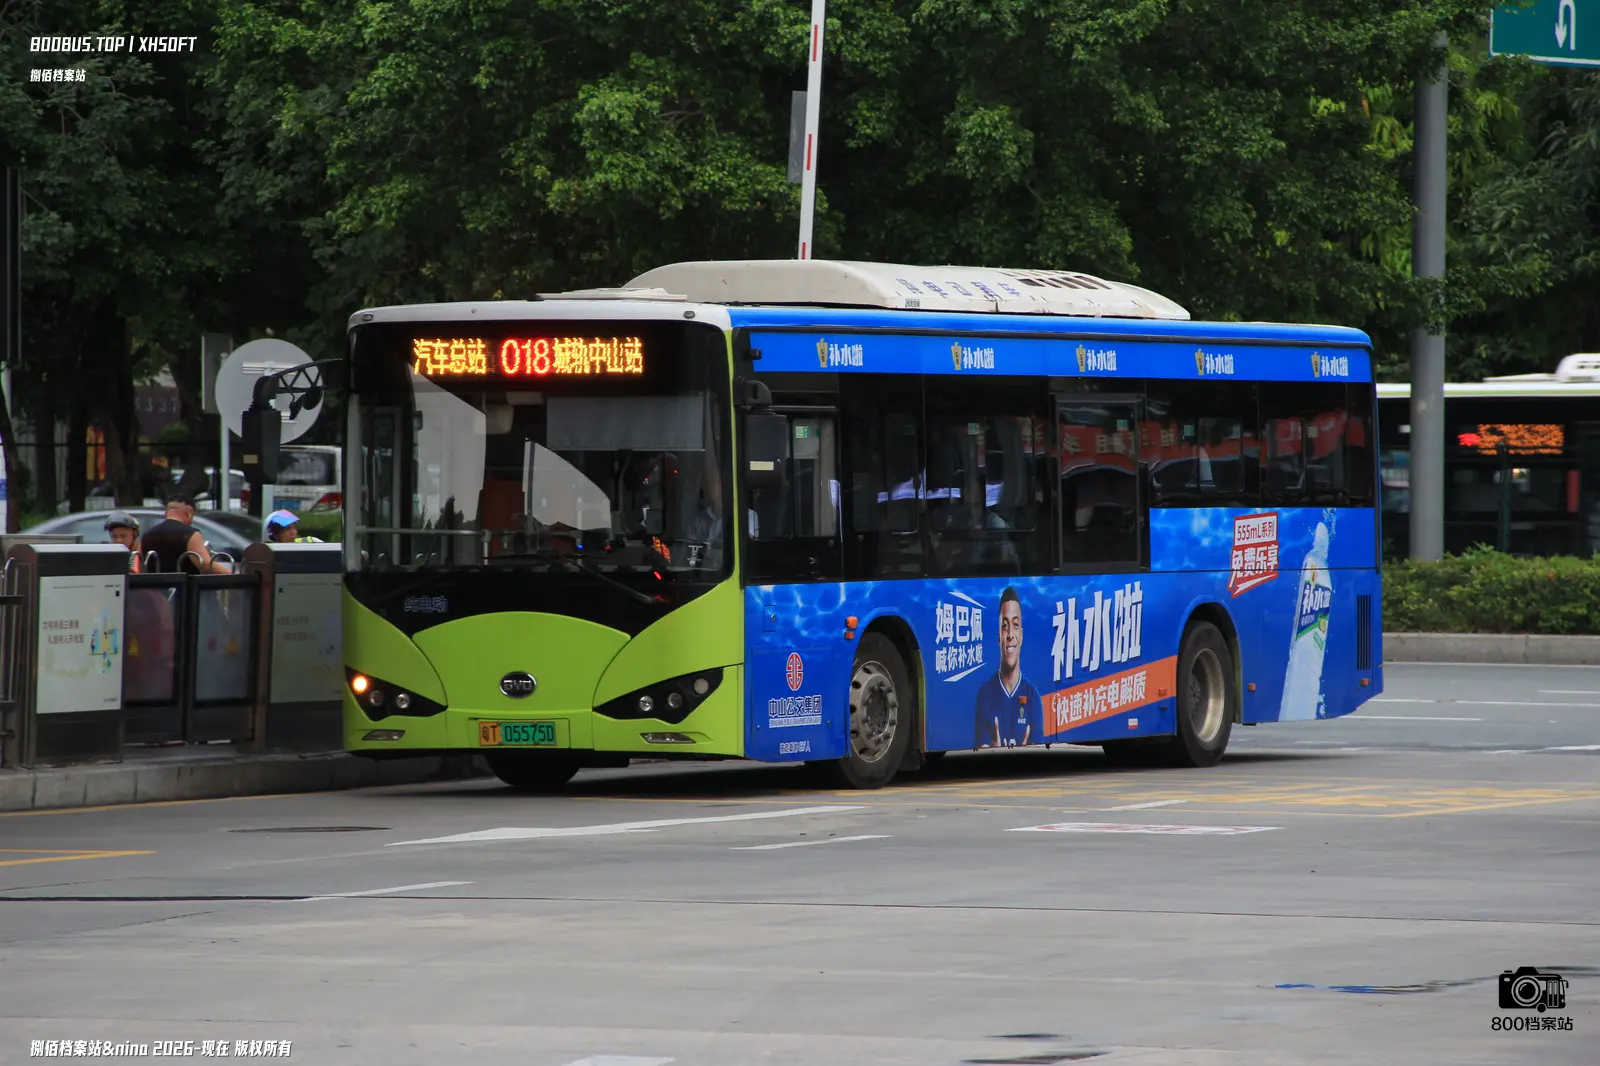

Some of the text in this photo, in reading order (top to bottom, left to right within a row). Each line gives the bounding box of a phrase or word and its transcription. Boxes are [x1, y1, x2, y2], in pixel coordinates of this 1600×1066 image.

[413, 337, 643, 375] 汽车总站 018 城轨中山站
[829, 344, 863, 366] 补水啦
[963, 348, 994, 369] 补水啦
[1087, 349, 1117, 371] 补水啦
[1205, 353, 1234, 375] 补水啦
[1321, 356, 1348, 376] 补水啦
[1237, 521, 1275, 541] 555mL系列
[1229, 544, 1279, 588] 免费乐享
[935, 600, 983, 644] 姆巴佩
[1051, 581, 1142, 682] 补水啦
[935, 643, 983, 674] 喊你补水啦
[503, 679, 532, 691] BYD
[768, 695, 822, 717] 中山公交集团
[1056, 671, 1147, 727] 快速补充电解质
